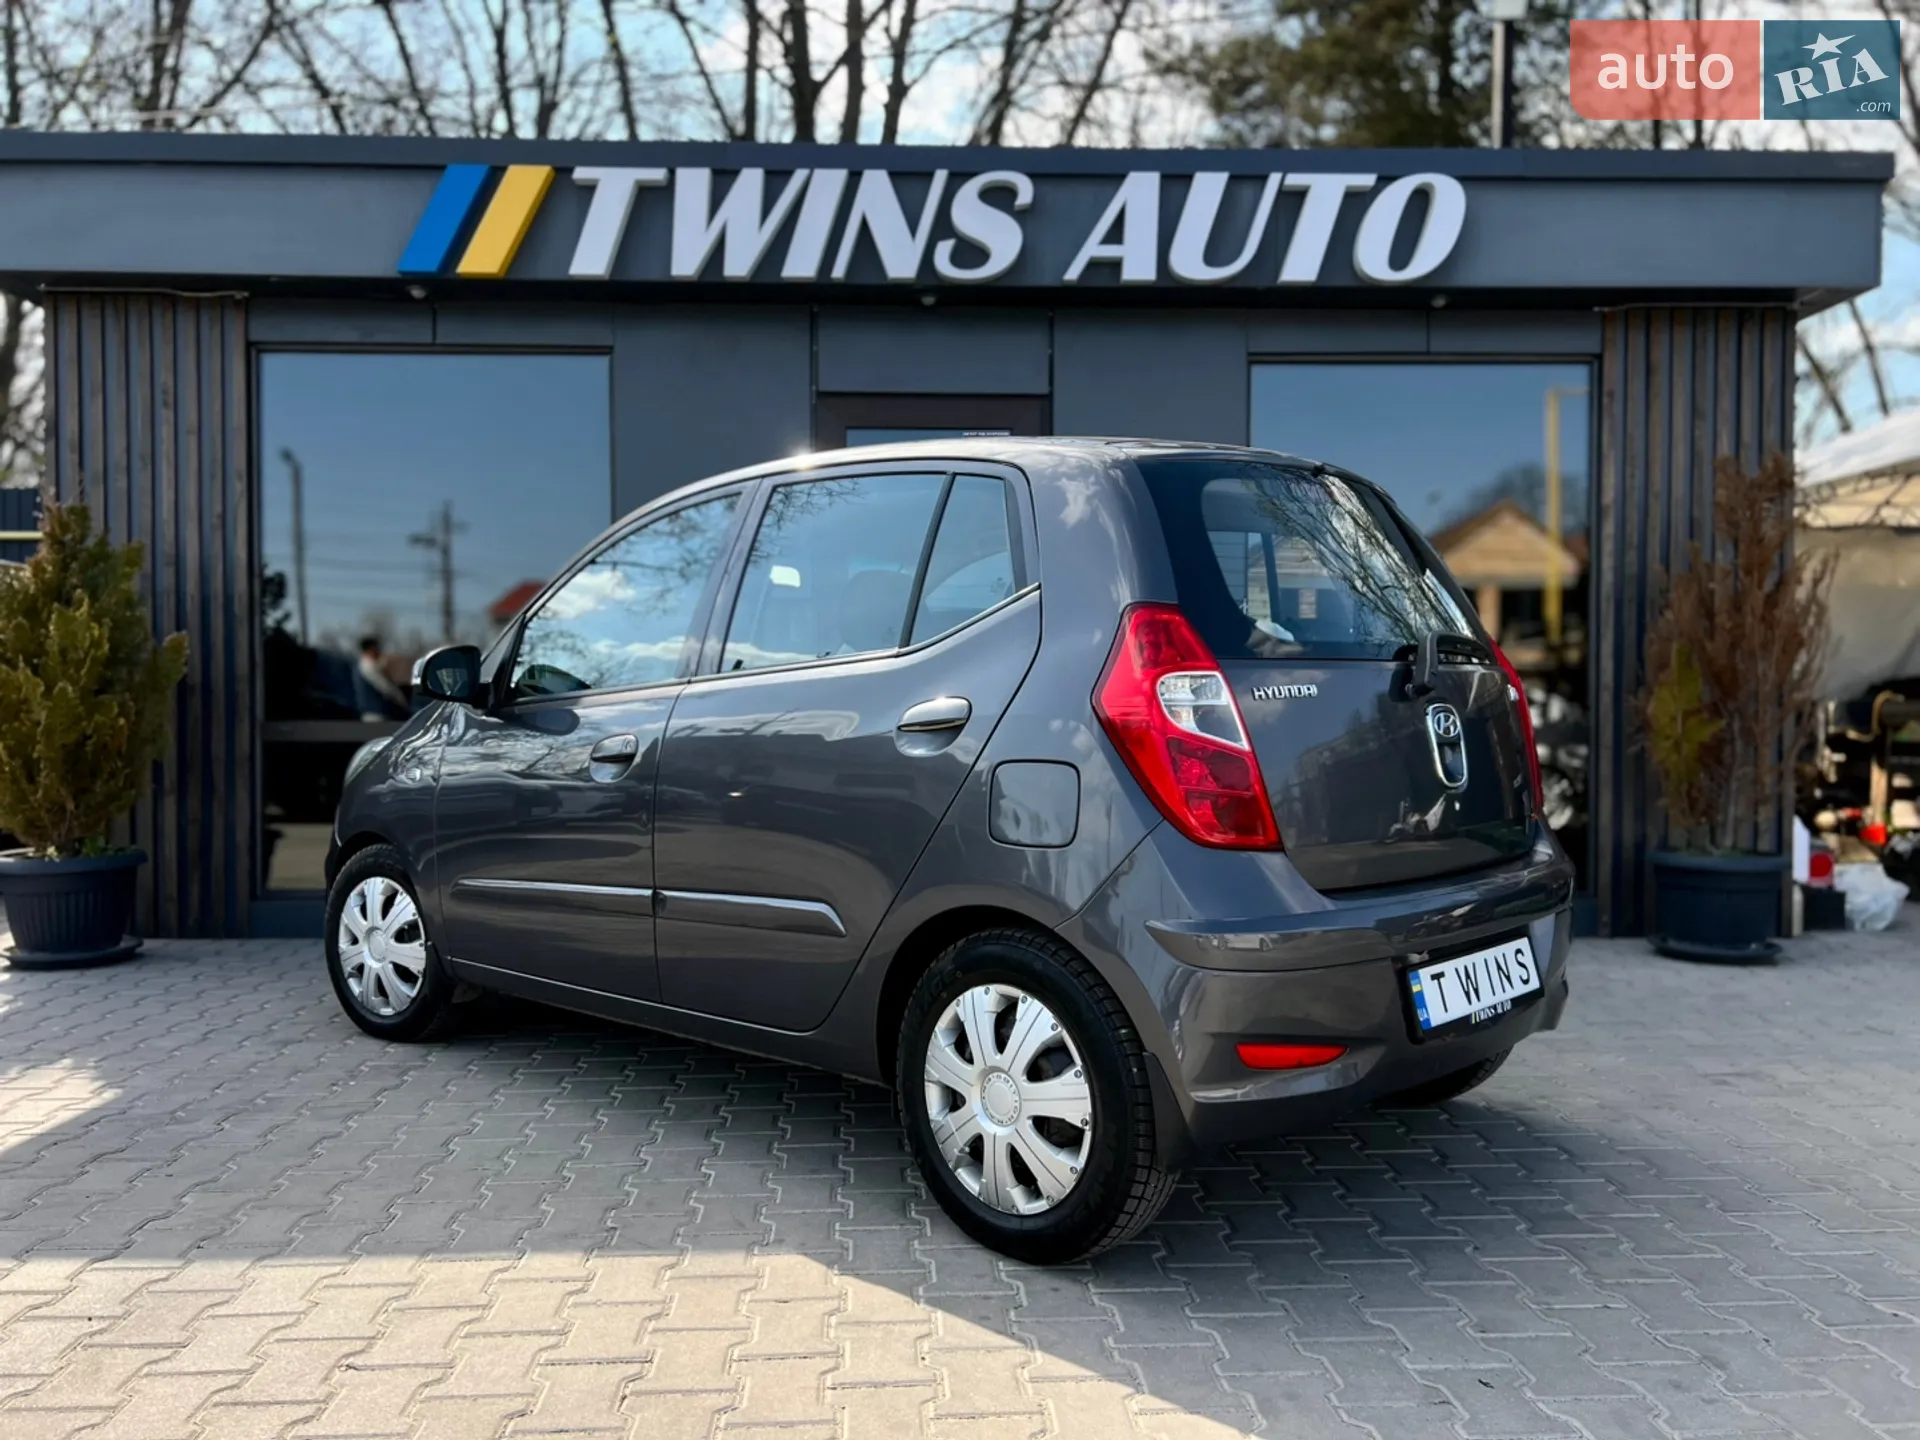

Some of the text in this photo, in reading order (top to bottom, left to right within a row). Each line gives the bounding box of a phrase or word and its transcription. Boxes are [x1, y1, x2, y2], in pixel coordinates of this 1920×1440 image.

[568, 165, 1467, 285] TWINS AUTO
[1252, 684, 1318, 700] HYUNDAI
[1430, 948, 1531, 1014] TWINS
[1417, 1007, 1428, 1021] UA
